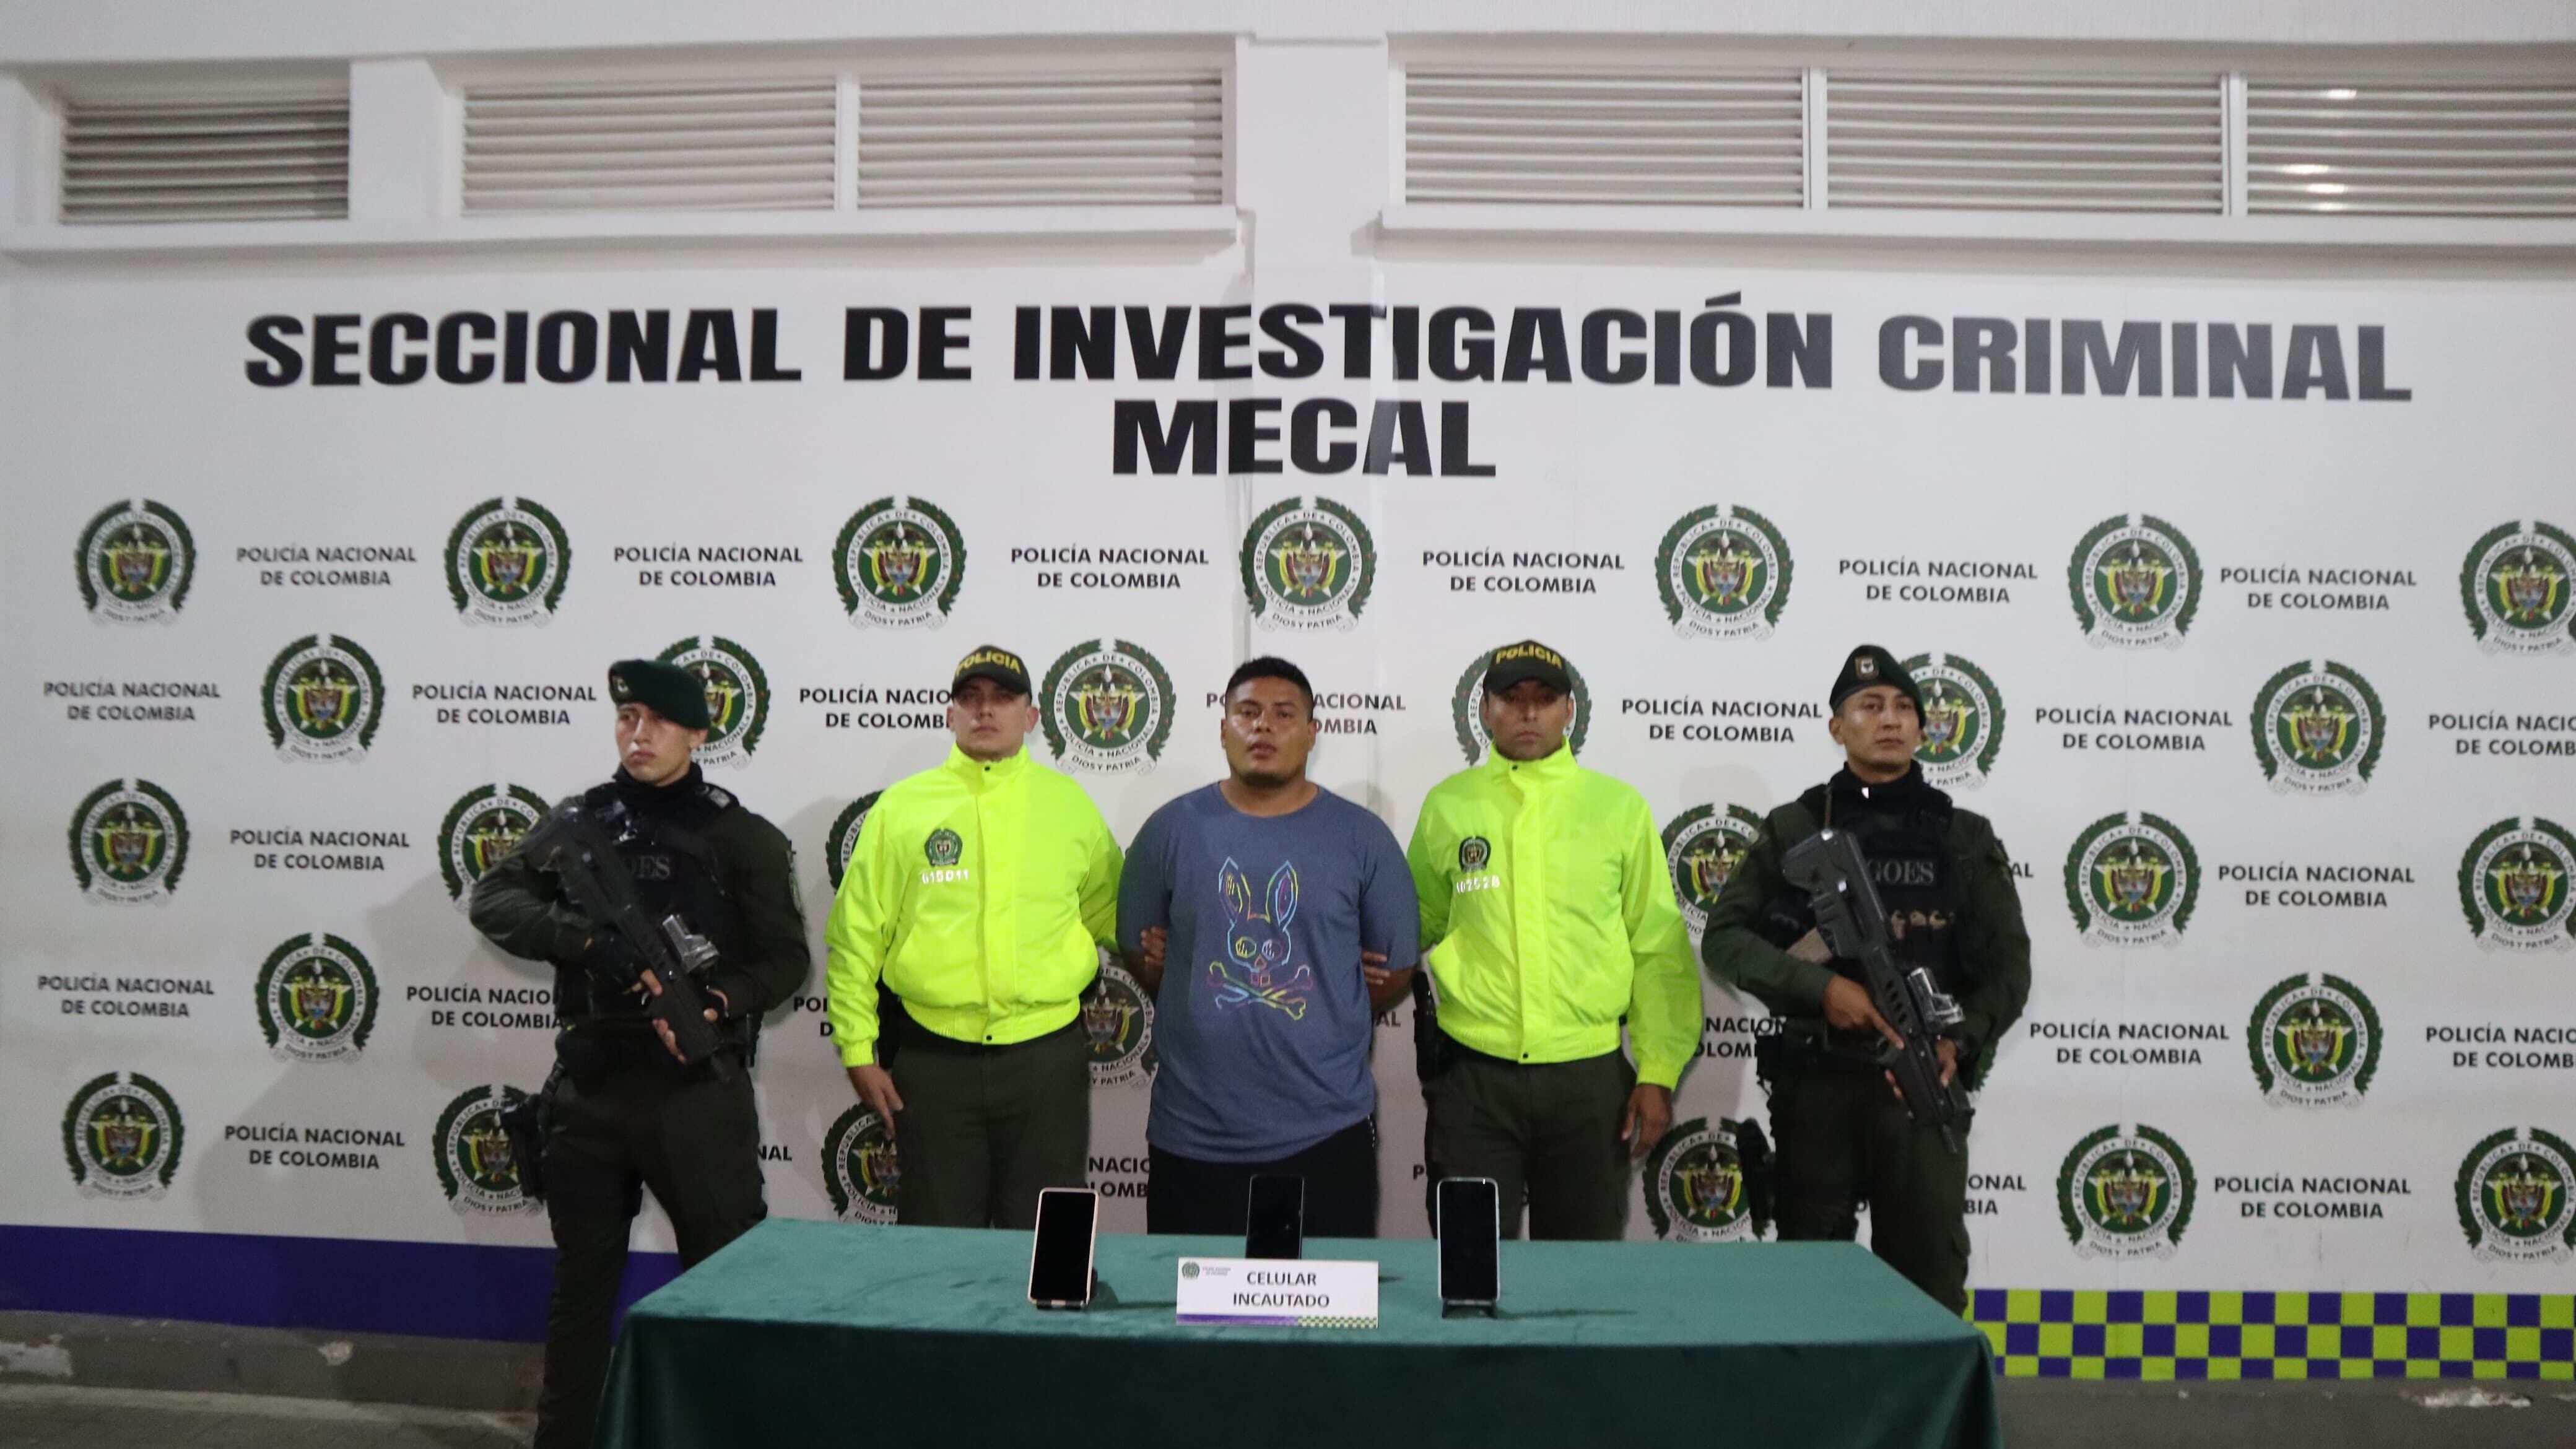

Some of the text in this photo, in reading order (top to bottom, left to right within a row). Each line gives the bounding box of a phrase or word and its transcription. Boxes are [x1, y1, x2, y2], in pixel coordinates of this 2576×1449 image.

[245, 291, 2413, 402] SECCIONAL DE INVESTIGACIÓN CRIMINAL
[1113, 398, 1496, 477] MECAL
[237, 542, 416, 563] POLICÍA NACIONAL
[614, 541, 803, 562] POLICÍA NACIONAL
[1011, 542, 1209, 564] POLICÍA NACIONAL
[1423, 546, 1624, 570] POLICÍA NACIONAL
[1839, 555, 2037, 579] POLICÍA NACIONAL
[2221, 562, 2416, 586] POLICÍA NACIONAL
[260, 570, 391, 586] DE COLOMBIA
[639, 571, 776, 586] DE COLOMBIA
[1037, 572, 1181, 588] DE COLOMBIA
[1450, 576, 1596, 593] DE COLOMBIA
[1866, 585, 2009, 603] DE COLOMBIA
[2248, 593, 2390, 610] DE COLOMBIA
[43, 678, 220, 698] POLICÍA NACIONAL
[412, 679, 596, 702] POLICÍA NACIONAL
[799, 684, 952, 704] POLICÍA NACIO
[1313, 694, 1406, 710] ACIONAL
[1622, 694, 1822, 718] POLICÍA NACIONAL
[67, 705, 196, 721] DE COLOMBIA
[437, 708, 570, 724] DE COLOMBIA
[825, 713, 949, 729] DE COLOMB
[2035, 703, 2233, 726] POLICÍA NACIONAL
[2429, 710, 2576, 731] POLICÍA NACIO
[1649, 724, 1794, 742] DE COLOMBIA
[2063, 733, 2205, 751] DE COLOMBIA
[2456, 739, 2576, 756] DE COLOMB
[230, 825, 410, 848] POLICÍA NACIONAL
[254, 853, 385, 871] DE COLOMBIA
[2219, 859, 2415, 883] POLICÍA NACIONAL
[2245, 890, 2387, 907] DE COLOMBIA
[38, 972, 215, 995] POLICÍA NACIONAL
[407, 983, 555, 1005] POLICÍA NACIO
[61, 999, 189, 1017] DE COLOMBIA
[431, 1011, 455, 1026] DE
[2030, 1017, 2229, 1040] POLICÍA NACIONAL
[2426, 1022, 2576, 1044] POLICÍA NACIO
[2056, 1048, 2201, 1064] DE COLOMBIA
[2453, 1051, 2575, 1068] DE COLOMB
[225, 1121, 405, 1147] POLICÍA NACIONAL
[249, 1149, 380, 1170] DE COLOMBIA
[1089, 1157, 1150, 1173] NACIO
[1968, 1174, 2027, 1191] ONAL
[2214, 1172, 2411, 1194] POLICÍA NACIONAL
[2241, 1202, 2383, 1219] DE COLOMBIA
[1247, 1272, 1316, 1286] CELULAR
[1233, 1293, 1329, 1307] INCAUTADO
